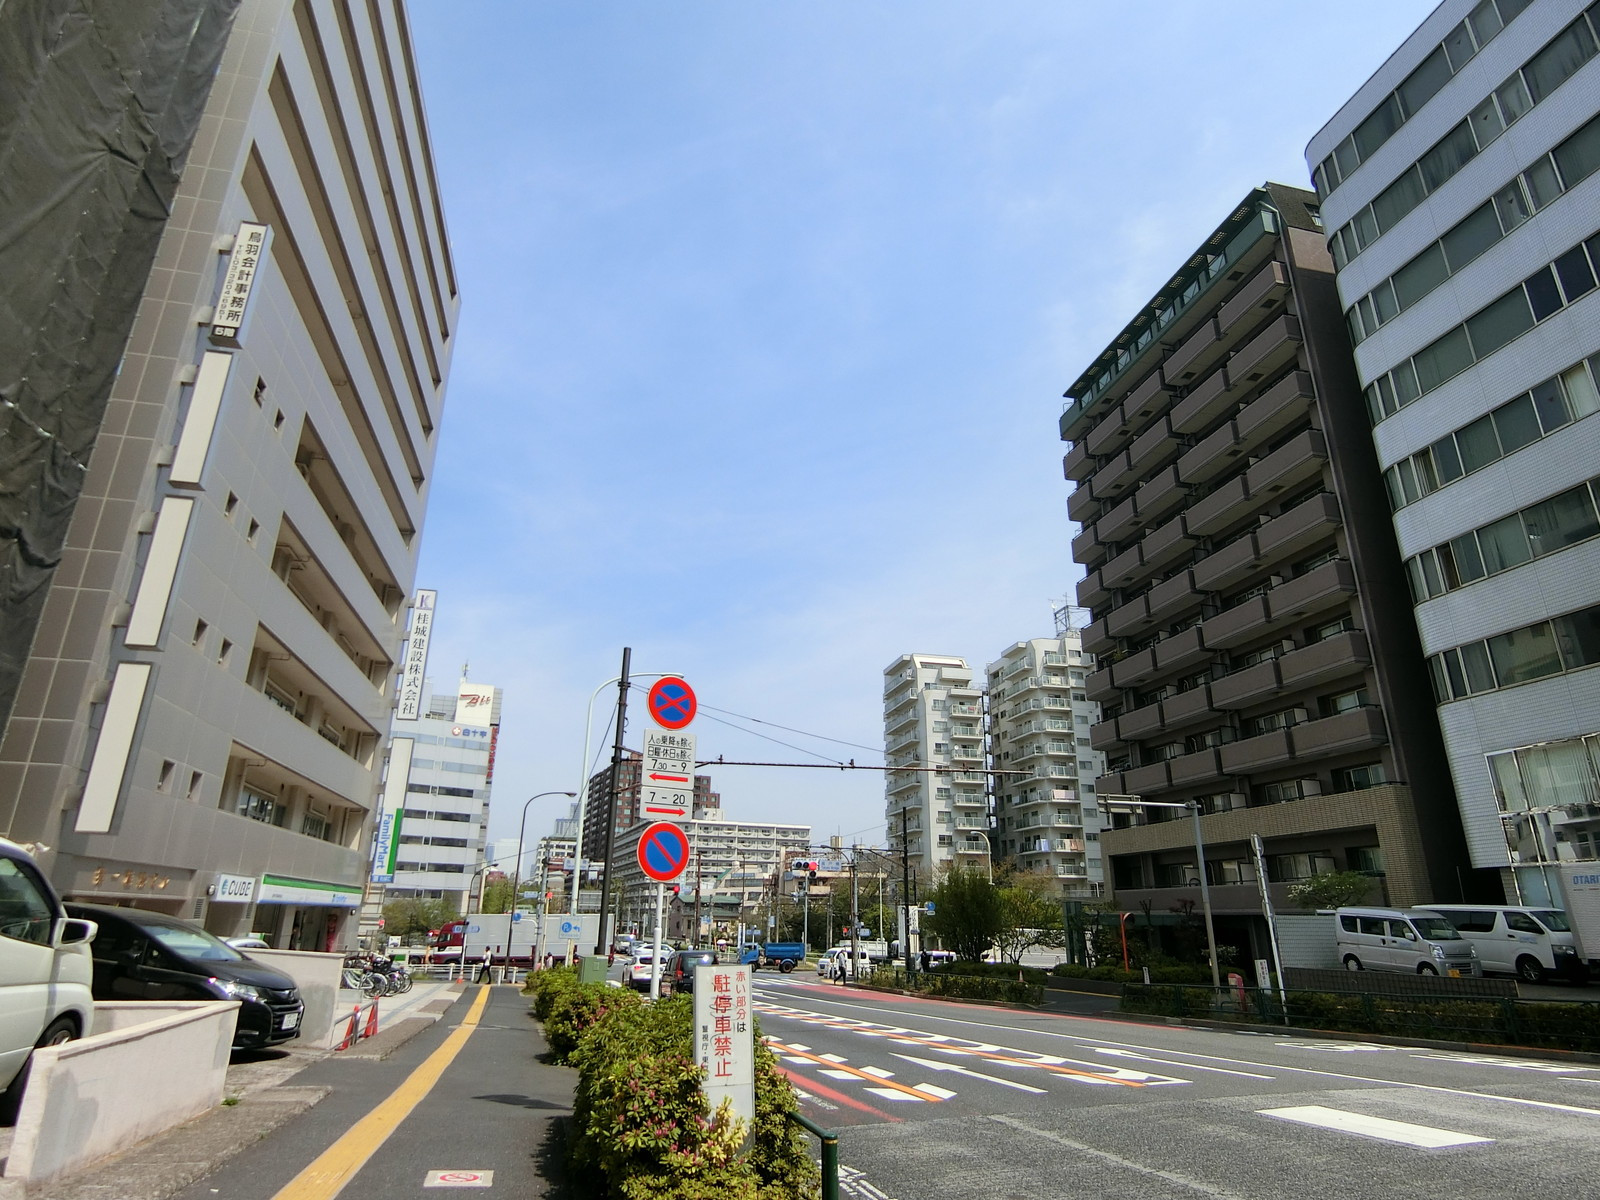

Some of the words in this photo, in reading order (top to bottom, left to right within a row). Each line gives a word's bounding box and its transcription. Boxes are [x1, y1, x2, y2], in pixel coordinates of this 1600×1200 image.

[402, 612, 429, 715] 桂城建設株式会社
[672, 794, 686, 805] 20
[376, 813, 394, 869] FamilyMart
[228, 880, 252, 896] CUBE
[1573, 875, 1600, 885] OTARI
[714, 974, 732, 1077] 駐停車禁止
[736, 971, 746, 1033] 赤い部分は
